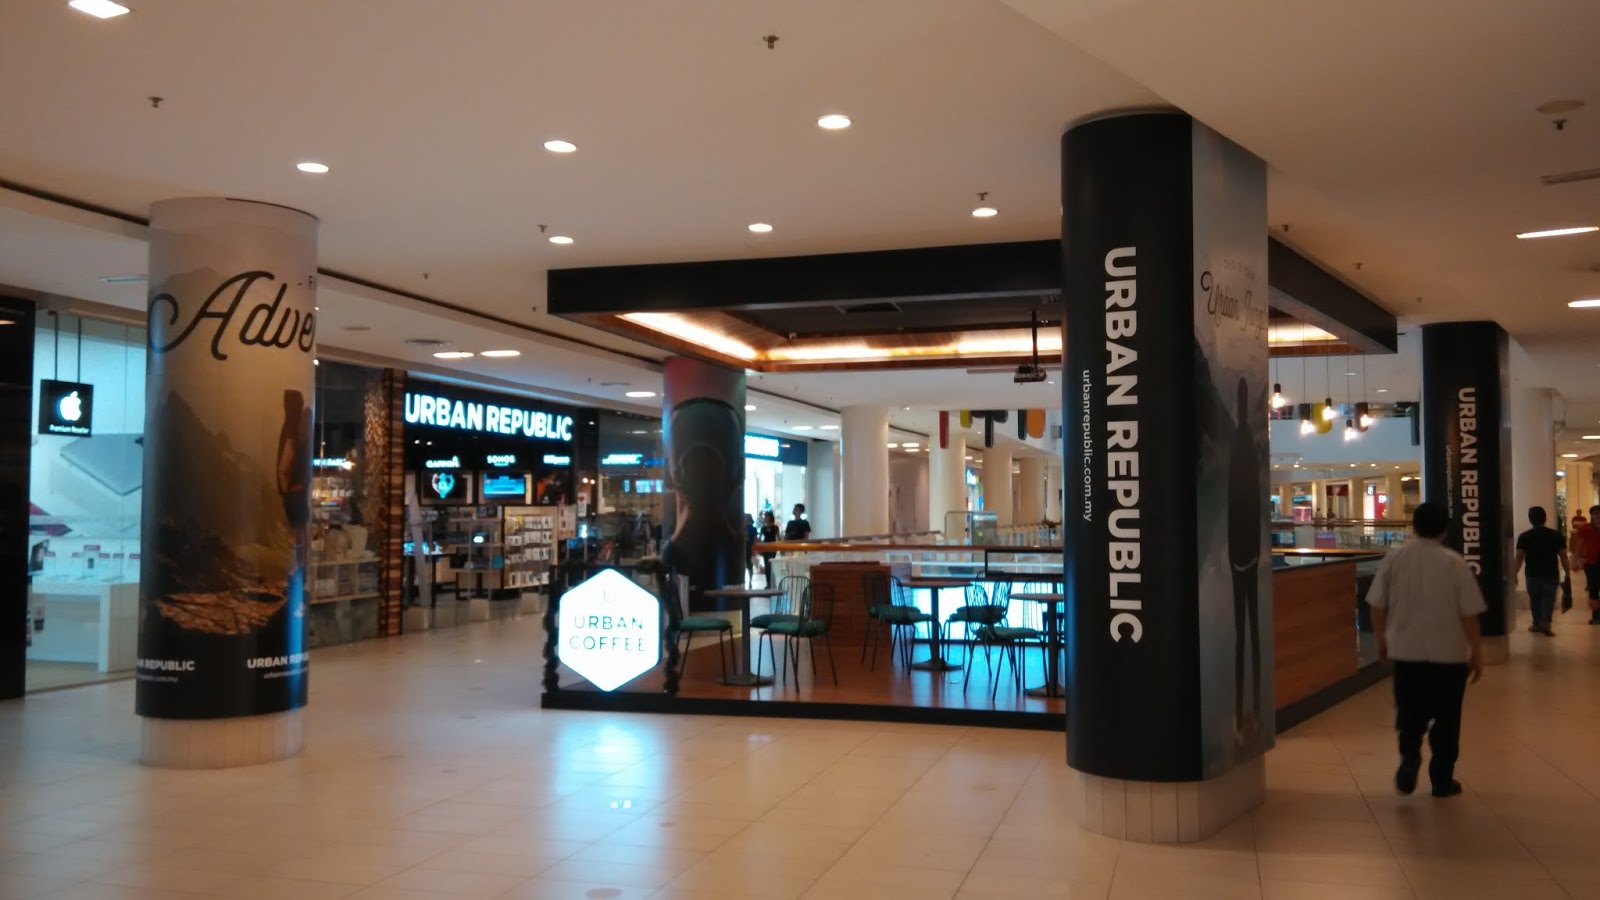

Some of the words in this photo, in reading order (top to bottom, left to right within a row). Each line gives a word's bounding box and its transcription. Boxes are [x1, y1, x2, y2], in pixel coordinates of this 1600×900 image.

[1104, 246, 1138, 406] URBAN
[405, 393, 482, 430] URBAN
[486, 405, 573, 441] REPUBLIC
[1458, 387, 1477, 464] URBAN
[487, 455, 515, 464] SONOS
[1082, 369, 1093, 522] urbanrepublic.com.my
[1107, 421, 1143, 643] REPUBLIC
[1461, 470, 1482, 576] REPUBLIC
[569, 636, 646, 651] COFFEE
[575, 615, 643, 629] URBAN
[145, 659, 195, 671] REPUBLIC
[247, 656, 287, 669] URBAN
